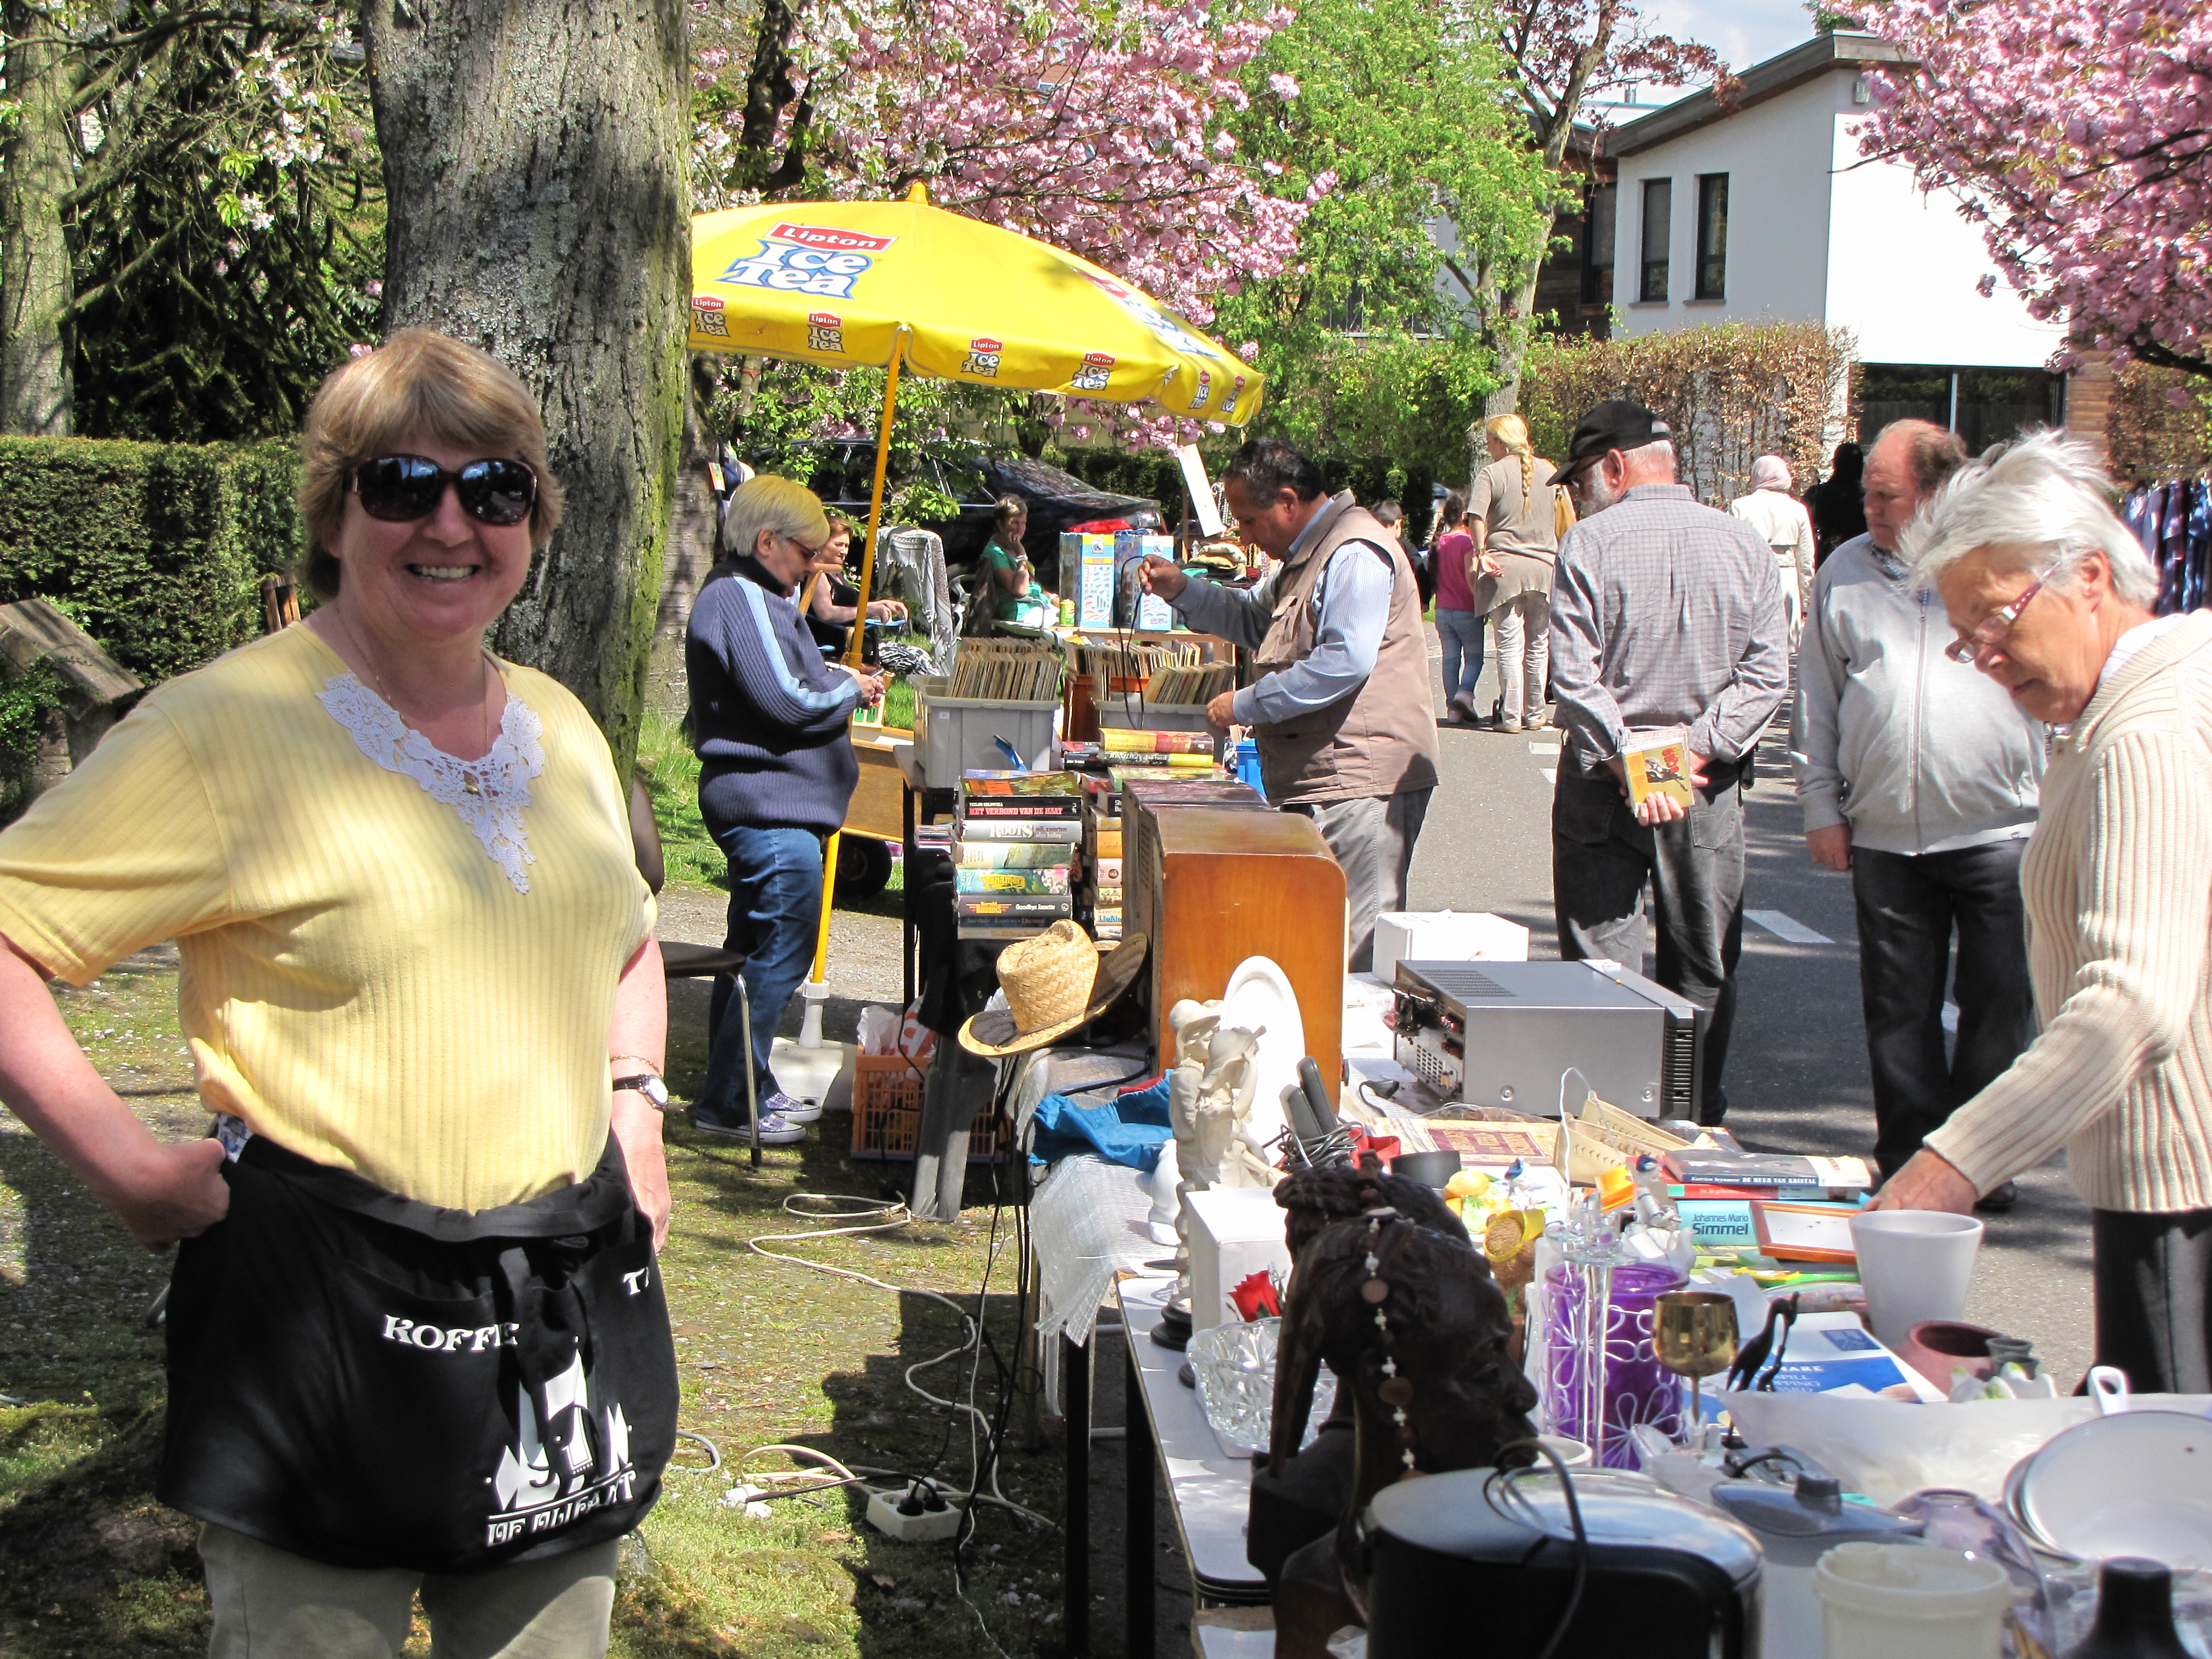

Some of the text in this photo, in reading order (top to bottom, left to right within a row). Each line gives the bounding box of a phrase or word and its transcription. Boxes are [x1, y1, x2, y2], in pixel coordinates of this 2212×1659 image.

[783, 227, 879, 249] Lipton
[749, 243, 871, 275] Ice
[729, 260, 854, 297] Tea
[694, 299, 722, 308] Lipton
[695, 310, 725, 326] Ice
[811, 315, 839, 326] Lipton
[696, 321, 729, 337] Tea
[809, 325, 841, 341] Ice
[808, 336, 844, 353] Tea
[973, 341, 1000, 350] Lipton
[967, 351, 1000, 367] Ice
[1086, 355, 1114, 364] Lipton
[961, 362, 997, 378] Tea
[1080, 363, 1111, 380] Ice
[1072, 375, 1108, 391] Tea
[988, 823, 1034, 839] ROOTS
[1693, 1213, 1749, 1222] Johannes Mario
[1692, 1222, 1749, 1235] Simmel
